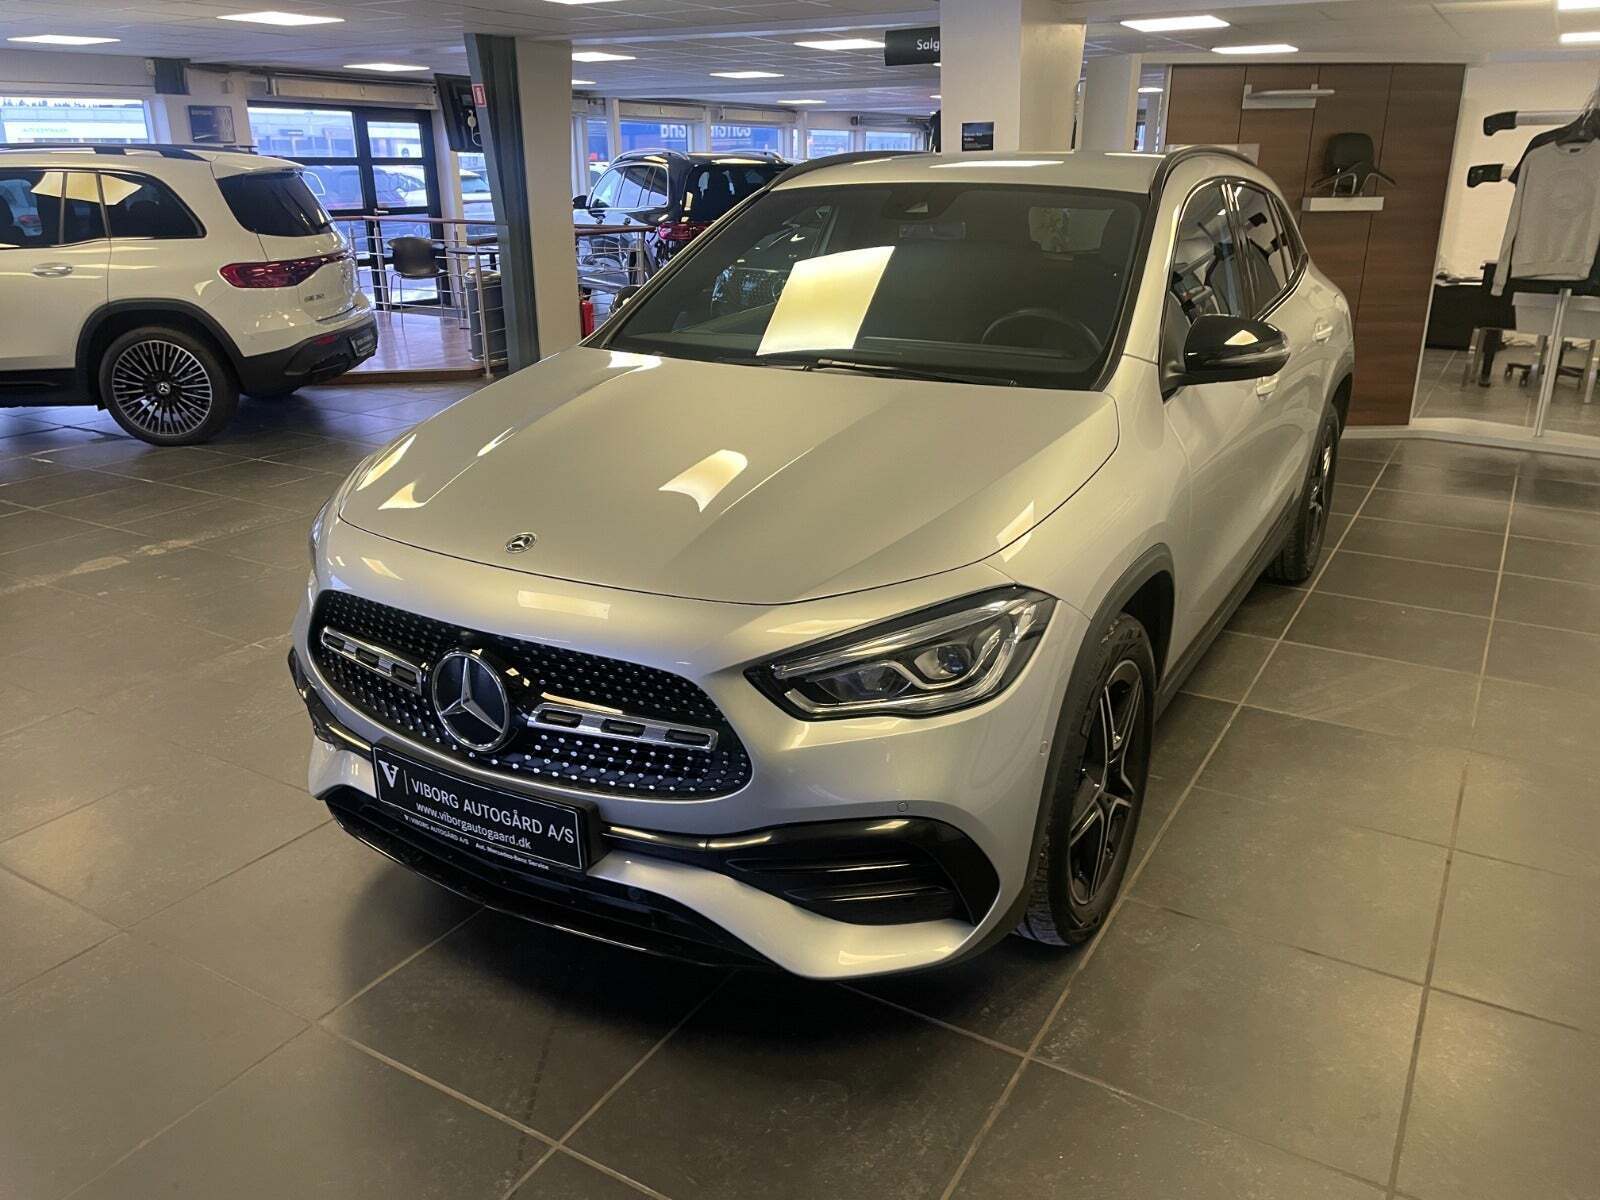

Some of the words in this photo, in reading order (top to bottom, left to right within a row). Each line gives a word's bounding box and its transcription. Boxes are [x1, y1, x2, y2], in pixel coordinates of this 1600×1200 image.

[916, 36, 940, 52] Salg
[411, 777, 459, 809] VIBORG
[463, 799, 543, 835] AUTOGÅRD
[547, 824, 575, 845] A/S
[415, 801, 532, 849] www.viborgautogaard.dk
